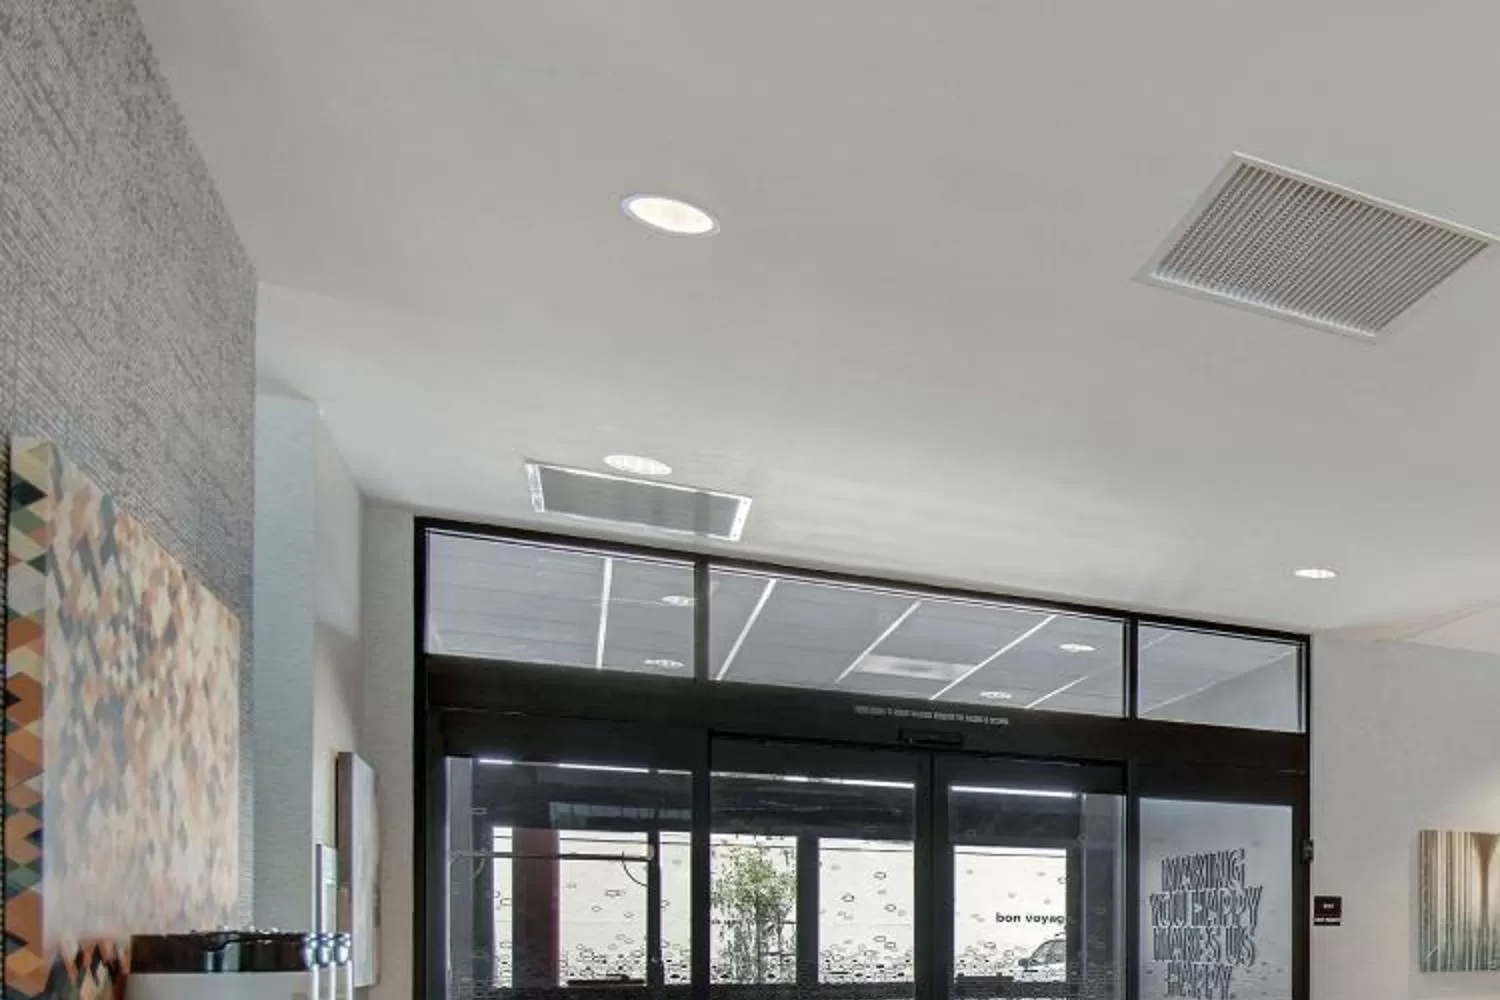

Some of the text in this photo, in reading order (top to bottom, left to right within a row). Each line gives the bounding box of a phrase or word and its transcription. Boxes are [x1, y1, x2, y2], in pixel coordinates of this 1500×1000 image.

[996, 911, 1065, 925] bon voyag
[1190, 884, 1263, 936] HAPPY
[1225, 926, 1256, 968] US
